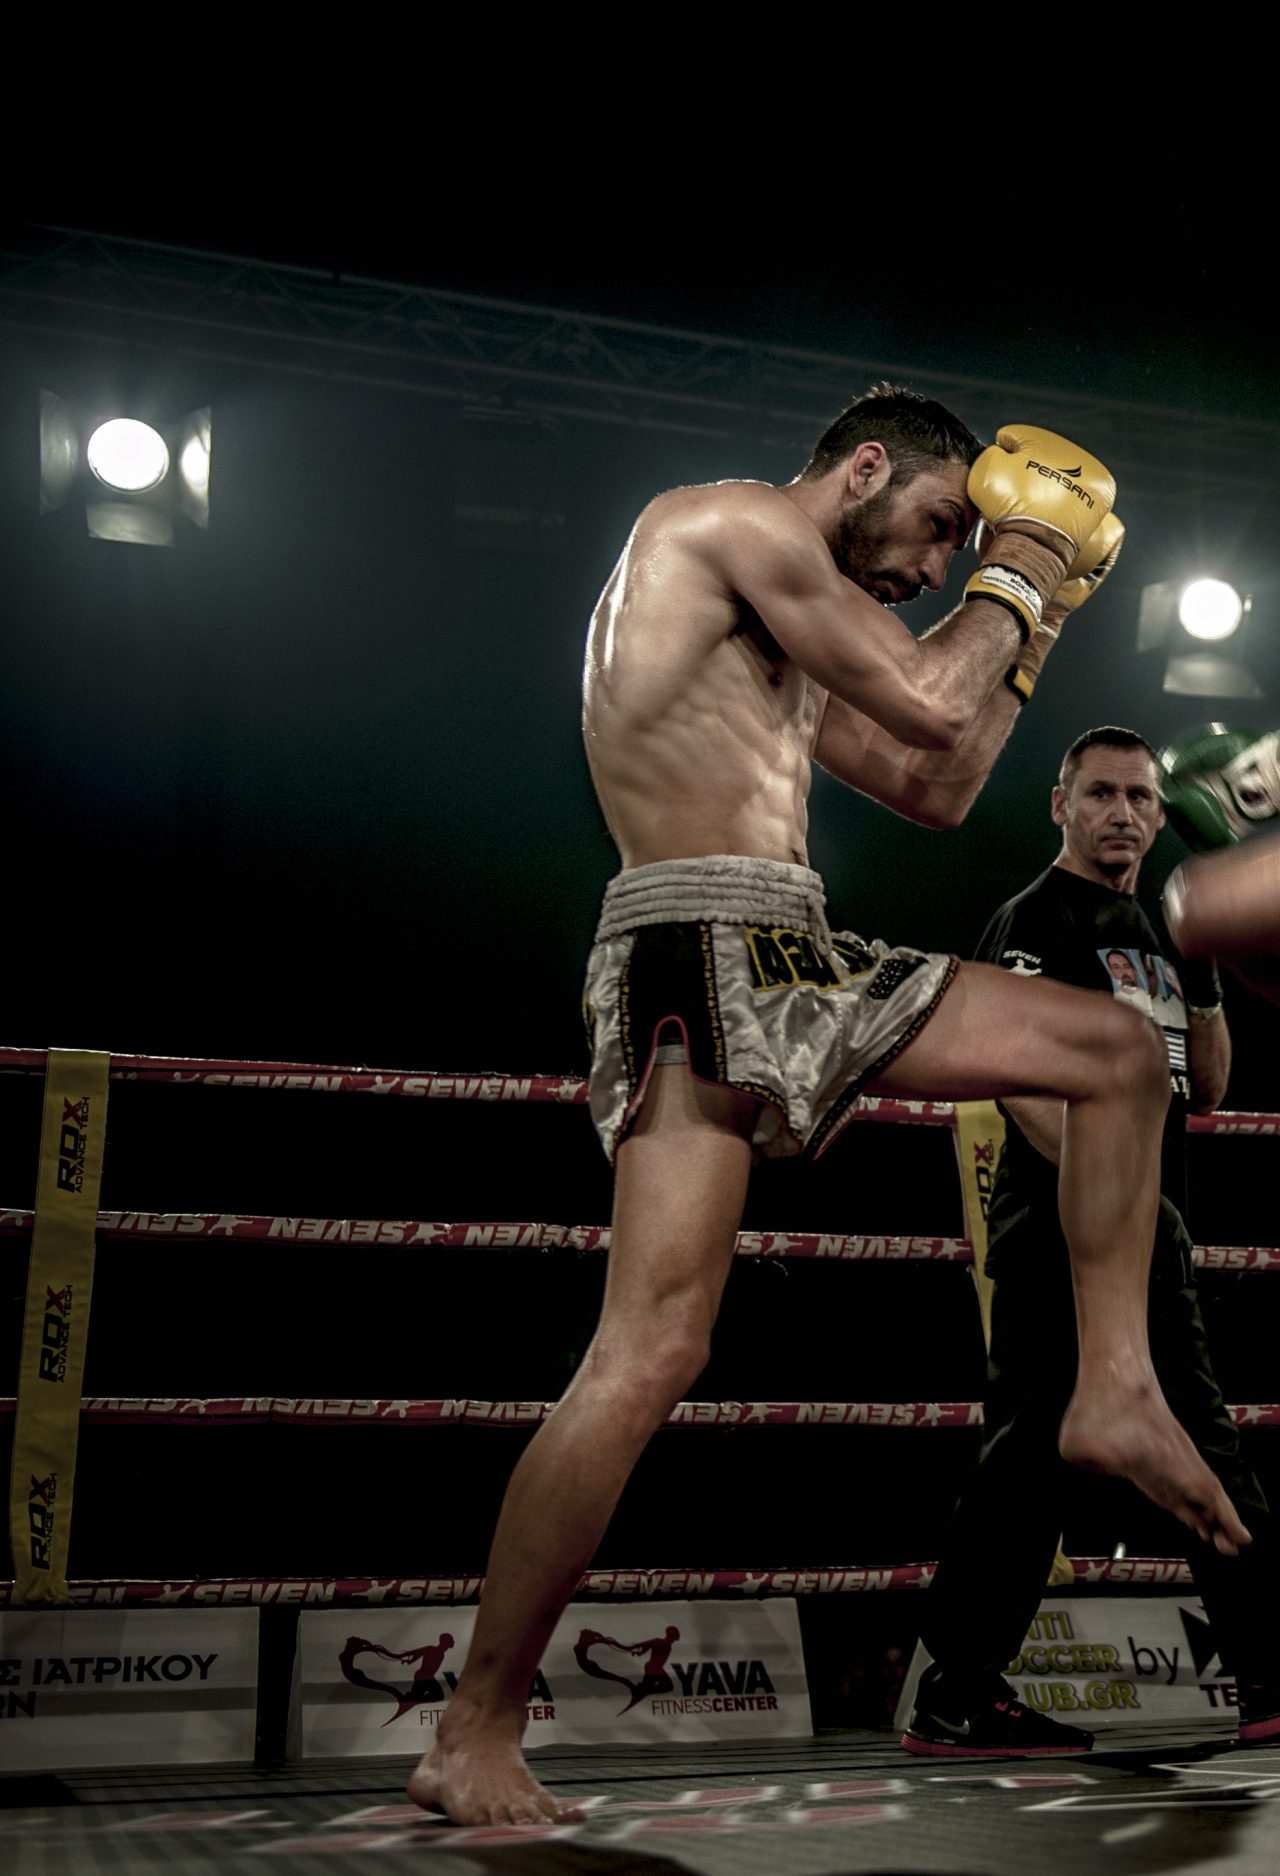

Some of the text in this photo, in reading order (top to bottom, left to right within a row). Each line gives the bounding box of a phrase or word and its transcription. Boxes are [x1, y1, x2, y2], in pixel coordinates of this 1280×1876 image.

[1026, 460, 1095, 510] PERSANI
[1002, 949, 1042, 965] SEVEN
[401, 1077, 531, 1100] SEVEN
[75, 1097, 91, 1194] ADVANCE TECH
[97, 1211, 207, 1233] SEVE
[268, 1216, 406, 1244] SEVEN
[465, 1223, 595, 1250] SEVEN
[816, 1236, 934, 1258] SEVEN
[63, 1285, 73, 1318] TECH
[795, 1403, 914, 1426] SEVEN
[194, 1582, 336, 1604] SEVEN
[586, 1572, 714, 1596] SEVEN
[767, 1570, 893, 1594] SEVEN
[1107, 1561, 1195, 1583] SEVE
[671, 1660, 776, 1697] YAVA
[1127, 1636, 1179, 1685] by
